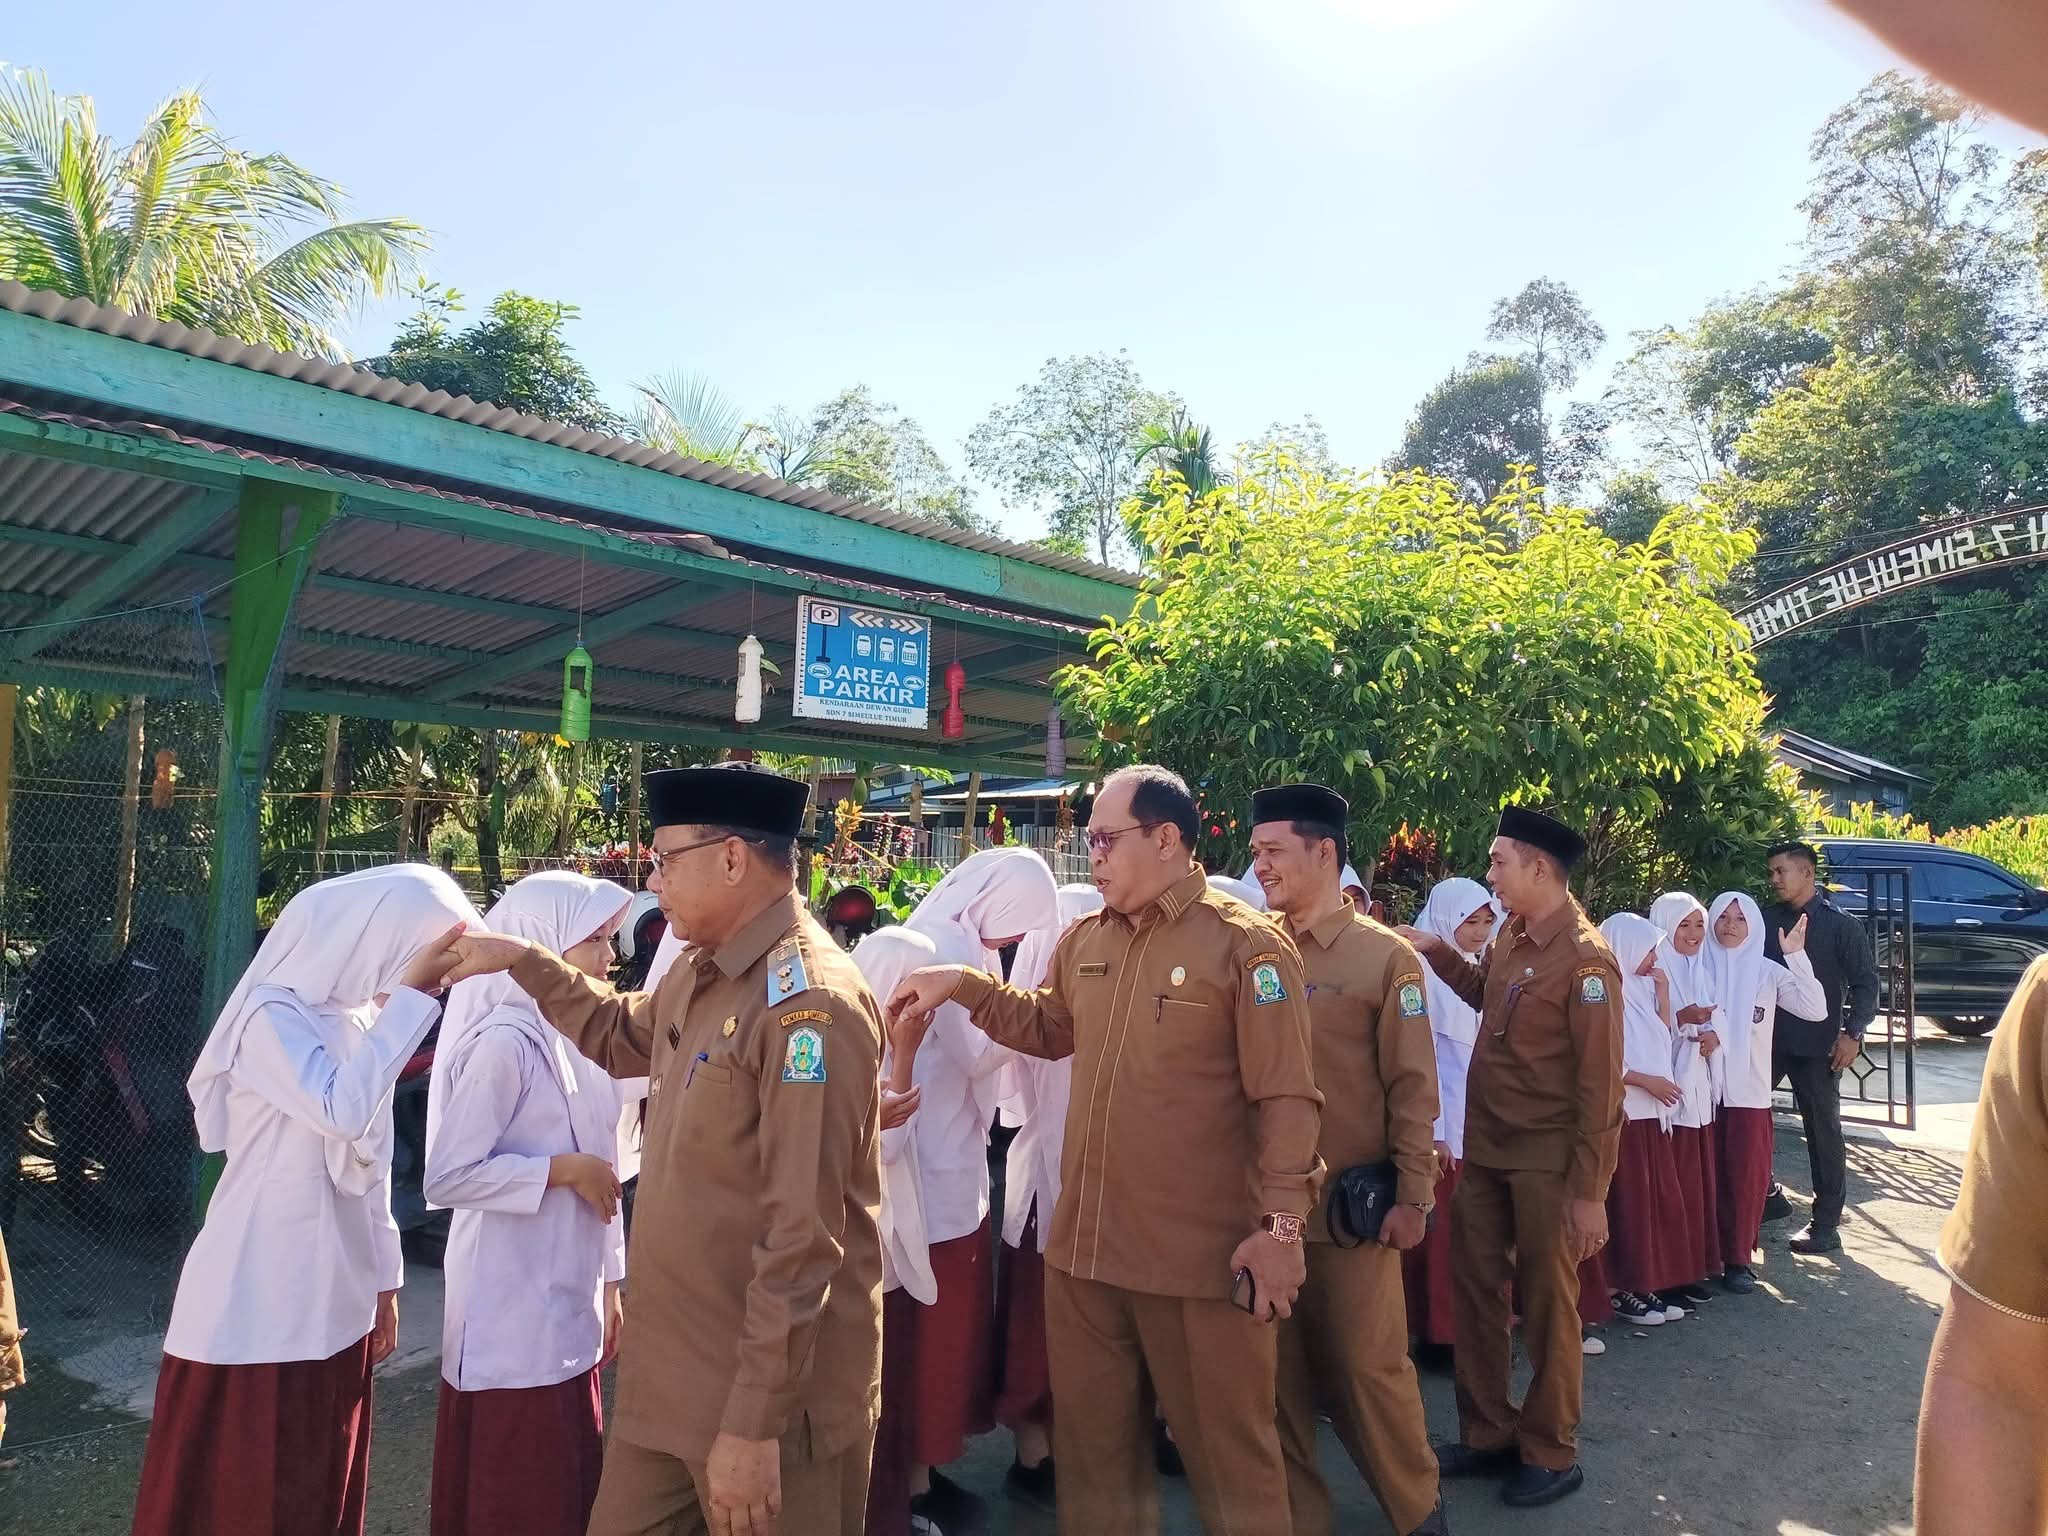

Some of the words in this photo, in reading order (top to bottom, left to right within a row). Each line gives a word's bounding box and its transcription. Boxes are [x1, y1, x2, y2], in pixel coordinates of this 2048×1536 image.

[820, 609, 832, 620] P
[835, 665, 900, 687] AREA
[818, 679, 914, 705] PARKIR
[819, 699, 865, 709] KENDARAAN
[865, 704, 892, 712] DEWAN
[847, 711, 884, 721] SIMEULUE
[885, 715, 907, 723] TIMUR
